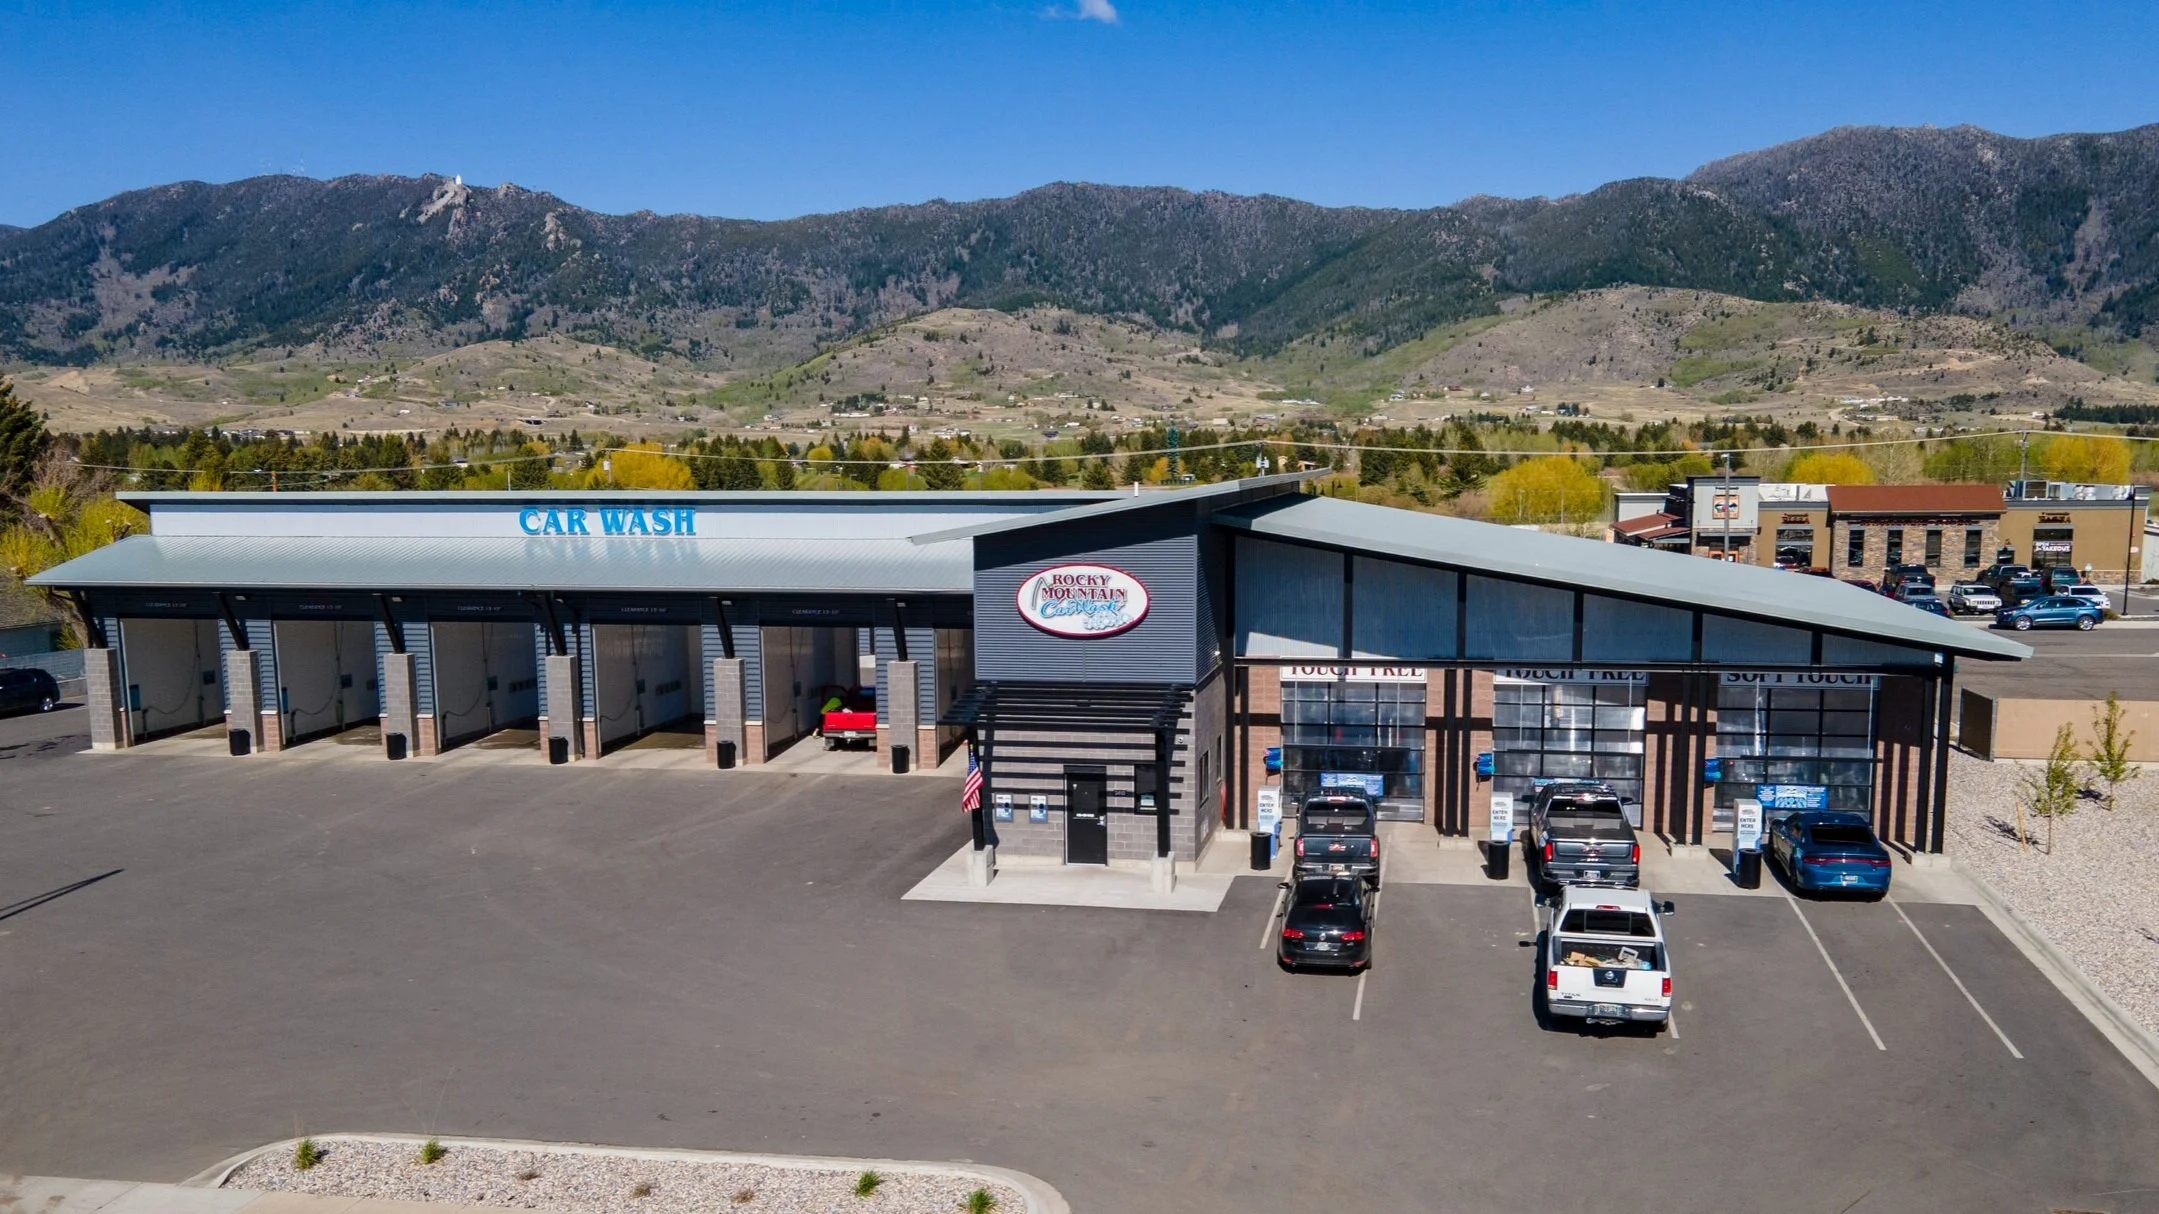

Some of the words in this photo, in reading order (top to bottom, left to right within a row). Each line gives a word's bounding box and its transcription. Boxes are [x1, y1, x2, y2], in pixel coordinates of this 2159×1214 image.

[518, 508, 590, 535] CAR
[598, 508, 697, 535] WASH
[1052, 574, 1110, 586] ROCKY
[1041, 587, 1127, 600] MOUNTAIN
